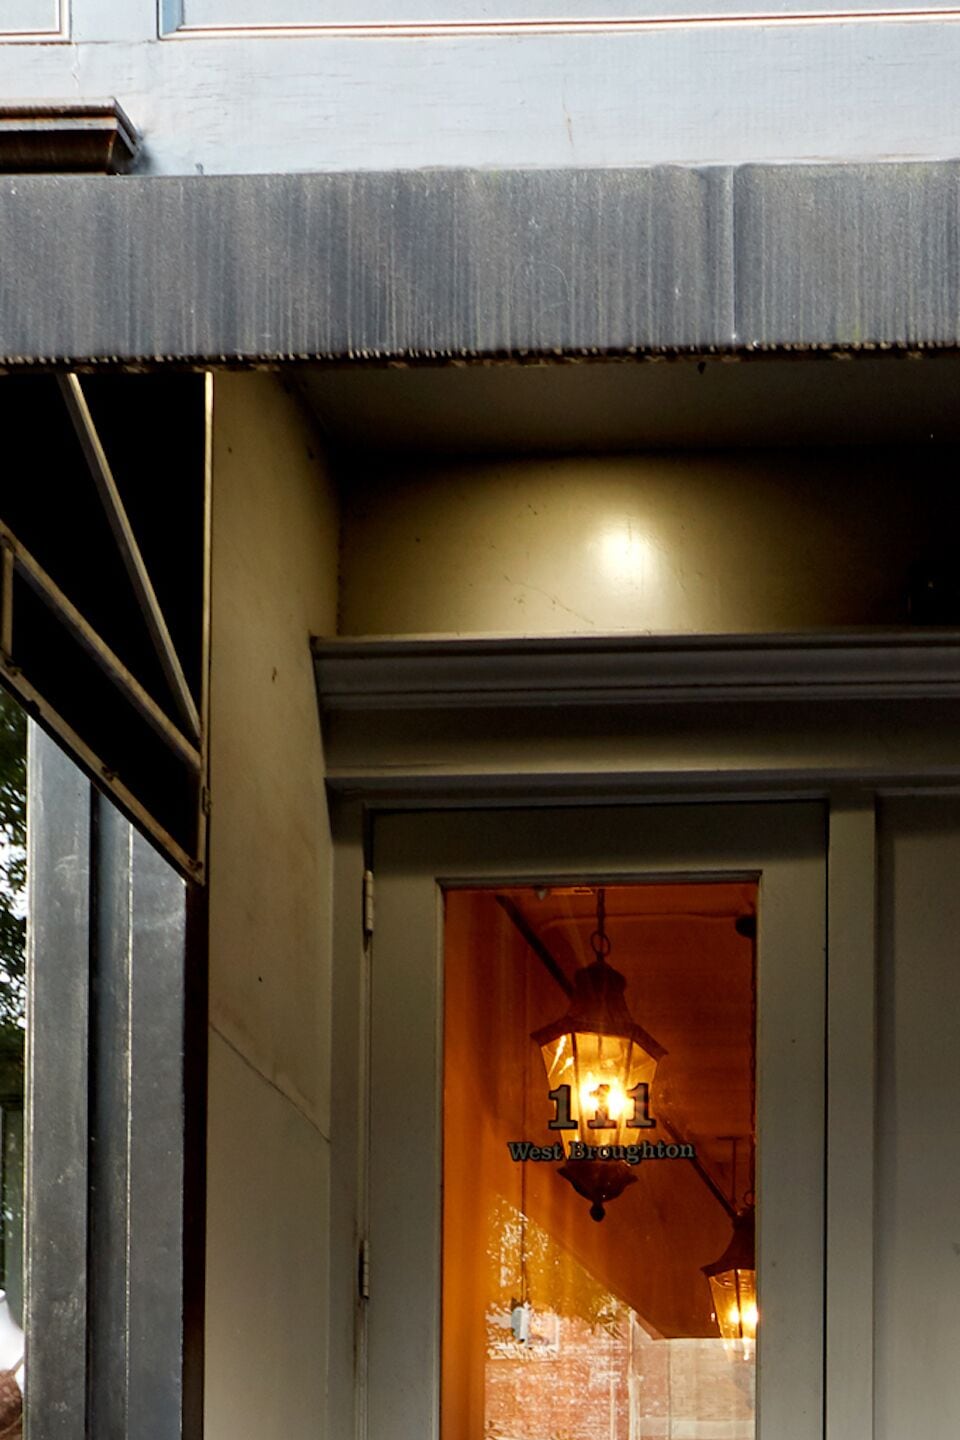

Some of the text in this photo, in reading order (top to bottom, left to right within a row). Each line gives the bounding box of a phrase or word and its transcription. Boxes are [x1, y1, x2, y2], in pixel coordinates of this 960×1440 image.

[548, 1083, 656, 1130] 111
[508, 1141, 696, 1164] West Broughton
